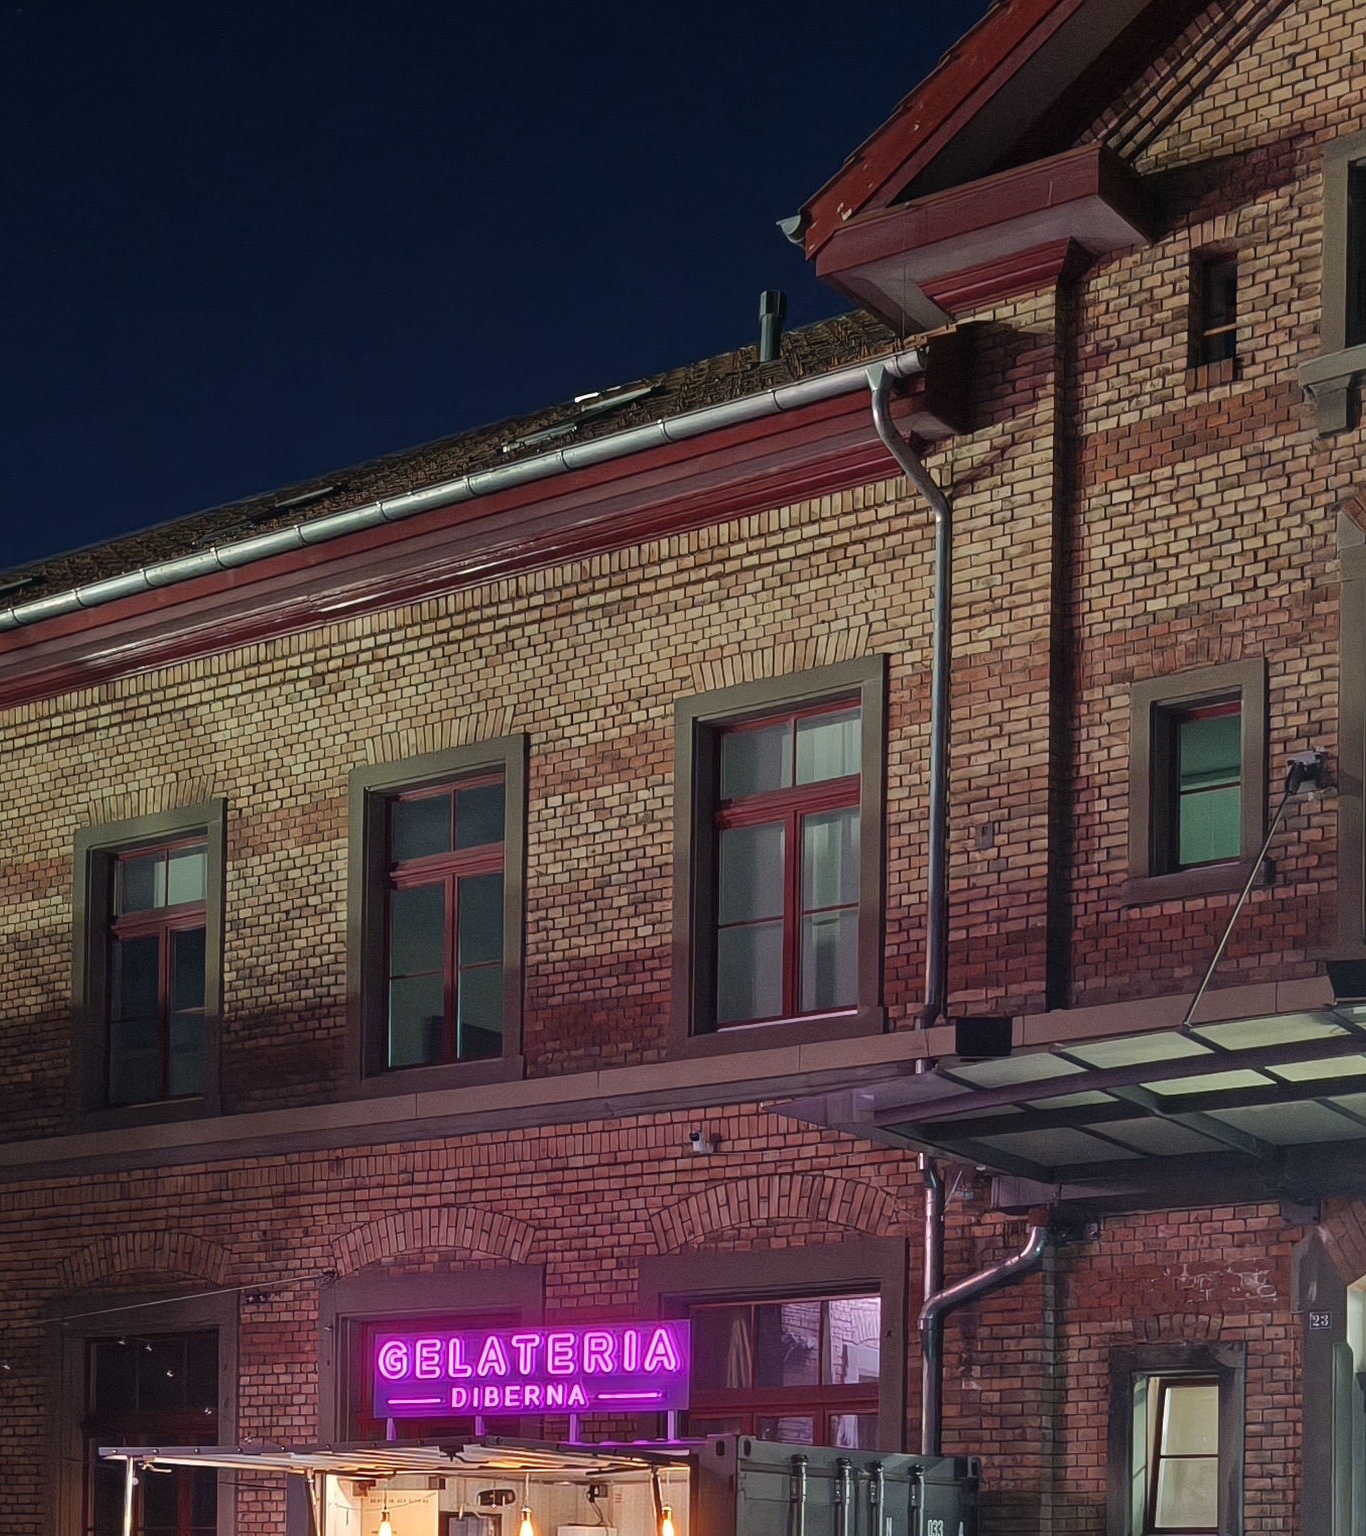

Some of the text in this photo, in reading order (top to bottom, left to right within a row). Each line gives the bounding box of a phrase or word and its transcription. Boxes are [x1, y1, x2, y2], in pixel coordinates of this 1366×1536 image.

[1312, 1314, 1329, 1327] 23
[377, 1327, 678, 1381] GELATERIA
[450, 1383, 587, 1409] DIBERNA
